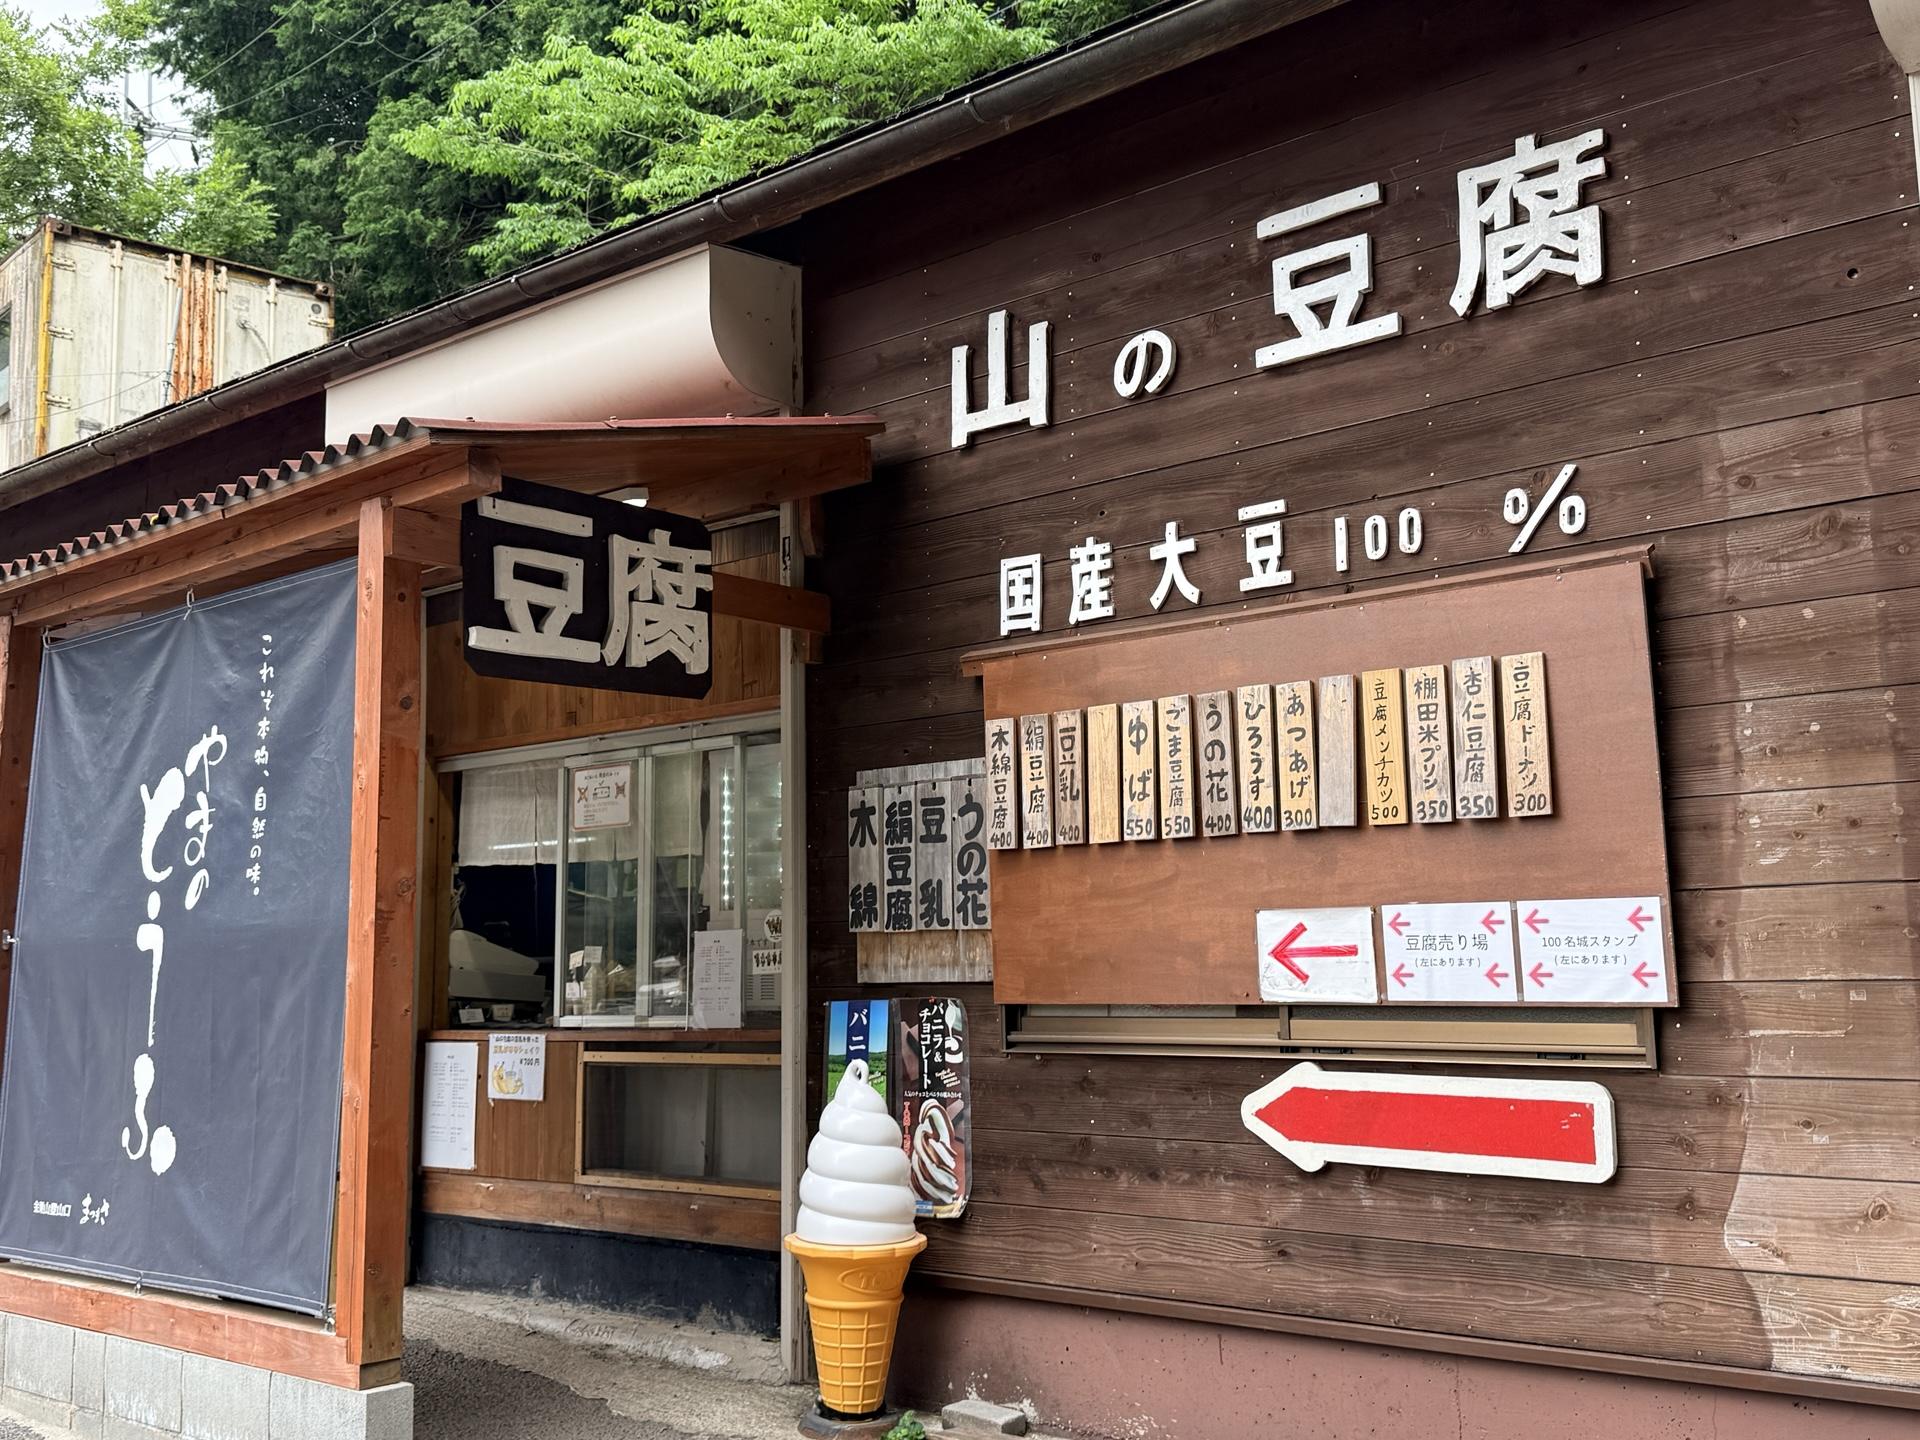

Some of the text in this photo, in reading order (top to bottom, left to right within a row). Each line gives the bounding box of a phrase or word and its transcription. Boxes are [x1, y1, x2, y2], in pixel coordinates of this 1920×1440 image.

[951, 128, 1606, 449] 山の豆腐
[468, 496, 713, 675] 豆腐
[246, 634, 274, 896] これぞ本物、自然の味。
[989, 725, 1012, 848] 木綿豆腐 400
[1025, 725, 1049, 845] 絹豆腐 400
[1059, 726, 1080, 841] 豆乳 400
[1126, 714, 1152, 836] ゆば 550
[1164, 707, 1190, 834] ごま豆腐 550
[1204, 703, 1231, 832] うの花 400
[1243, 701, 1272, 829] ひろうす 400
[1283, 693, 1312, 827] あつあげ 300
[1371, 678, 1398, 820] 豆腐メンチカツ 500
[1414, 676, 1448, 820] 棚田米プリン 350
[1460, 670, 1494, 816] 杏仁豆腐 350
[1510, 662, 1546, 812] 豆腐ドーナツ 300
[184, 725, 227, 911] やまの
[850, 800, 878, 929] 木綿
[885, 800, 913, 931] 絹豆腐
[919, 797, 950, 928] 豆乳
[956, 793, 988, 927] うの花
[122, 767, 185, 1176] とうふ
[1405, 933, 1489, 952] 豆腐売り場
[1414, 956, 1481, 968] (左にあります)
[1542, 934, 1638, 949] 100名城スタンプ
[1554, 954, 1628, 966] (左にあります)
[919, 1008, 933, 1090] チョコレート
[931, 1003, 944, 1063] バニラ&
